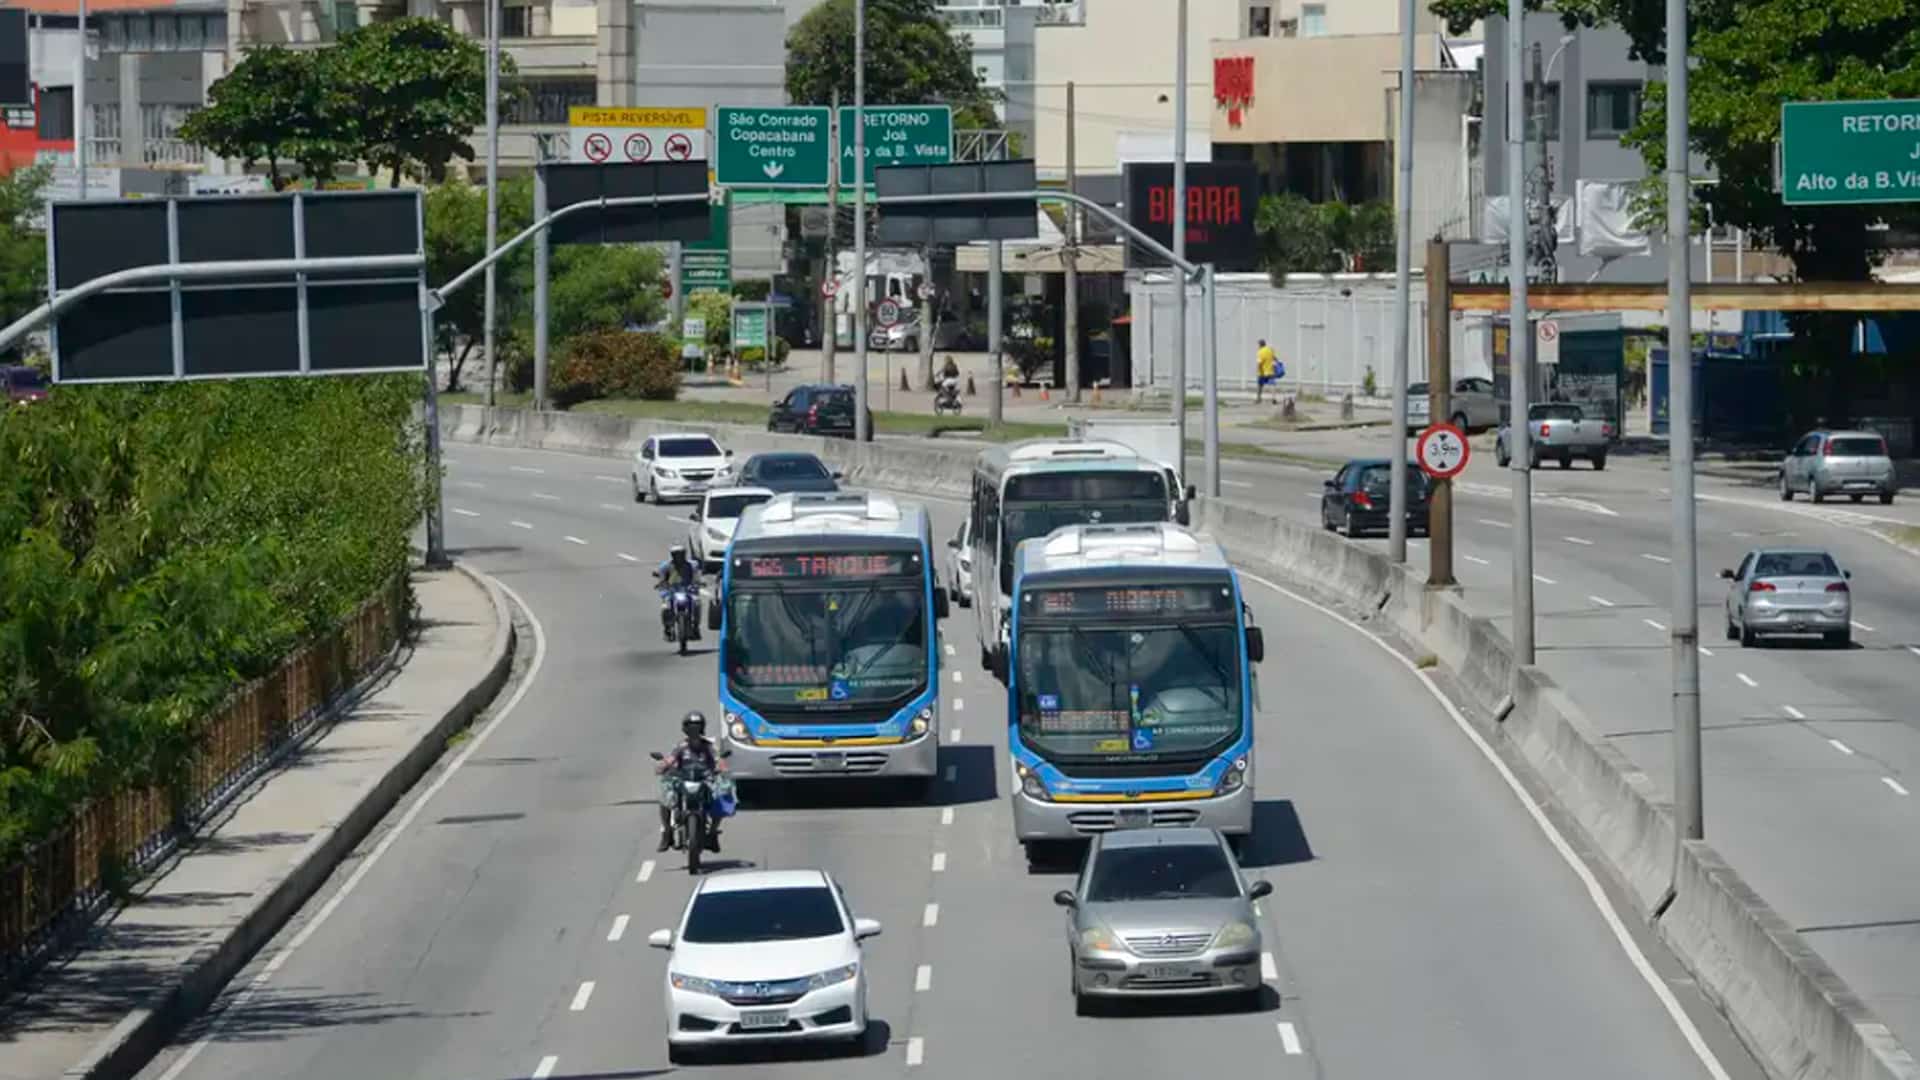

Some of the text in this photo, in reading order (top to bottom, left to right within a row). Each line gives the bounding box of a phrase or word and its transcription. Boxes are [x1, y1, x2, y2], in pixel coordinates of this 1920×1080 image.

[582, 111, 617, 122] PISTA
[728, 112, 818, 127] São Conrado
[730, 128, 816, 143] Copacabana
[882, 127, 909, 142] Joá
[748, 144, 797, 157] Centro
[843, 145, 871, 158] Ao
[874, 145, 892, 158] da
[914, 143, 948, 157] Vista
[1796, 173, 1838, 191] Alto
[1844, 172, 1869, 189] da
[796, 554, 890, 576] TANQUE
